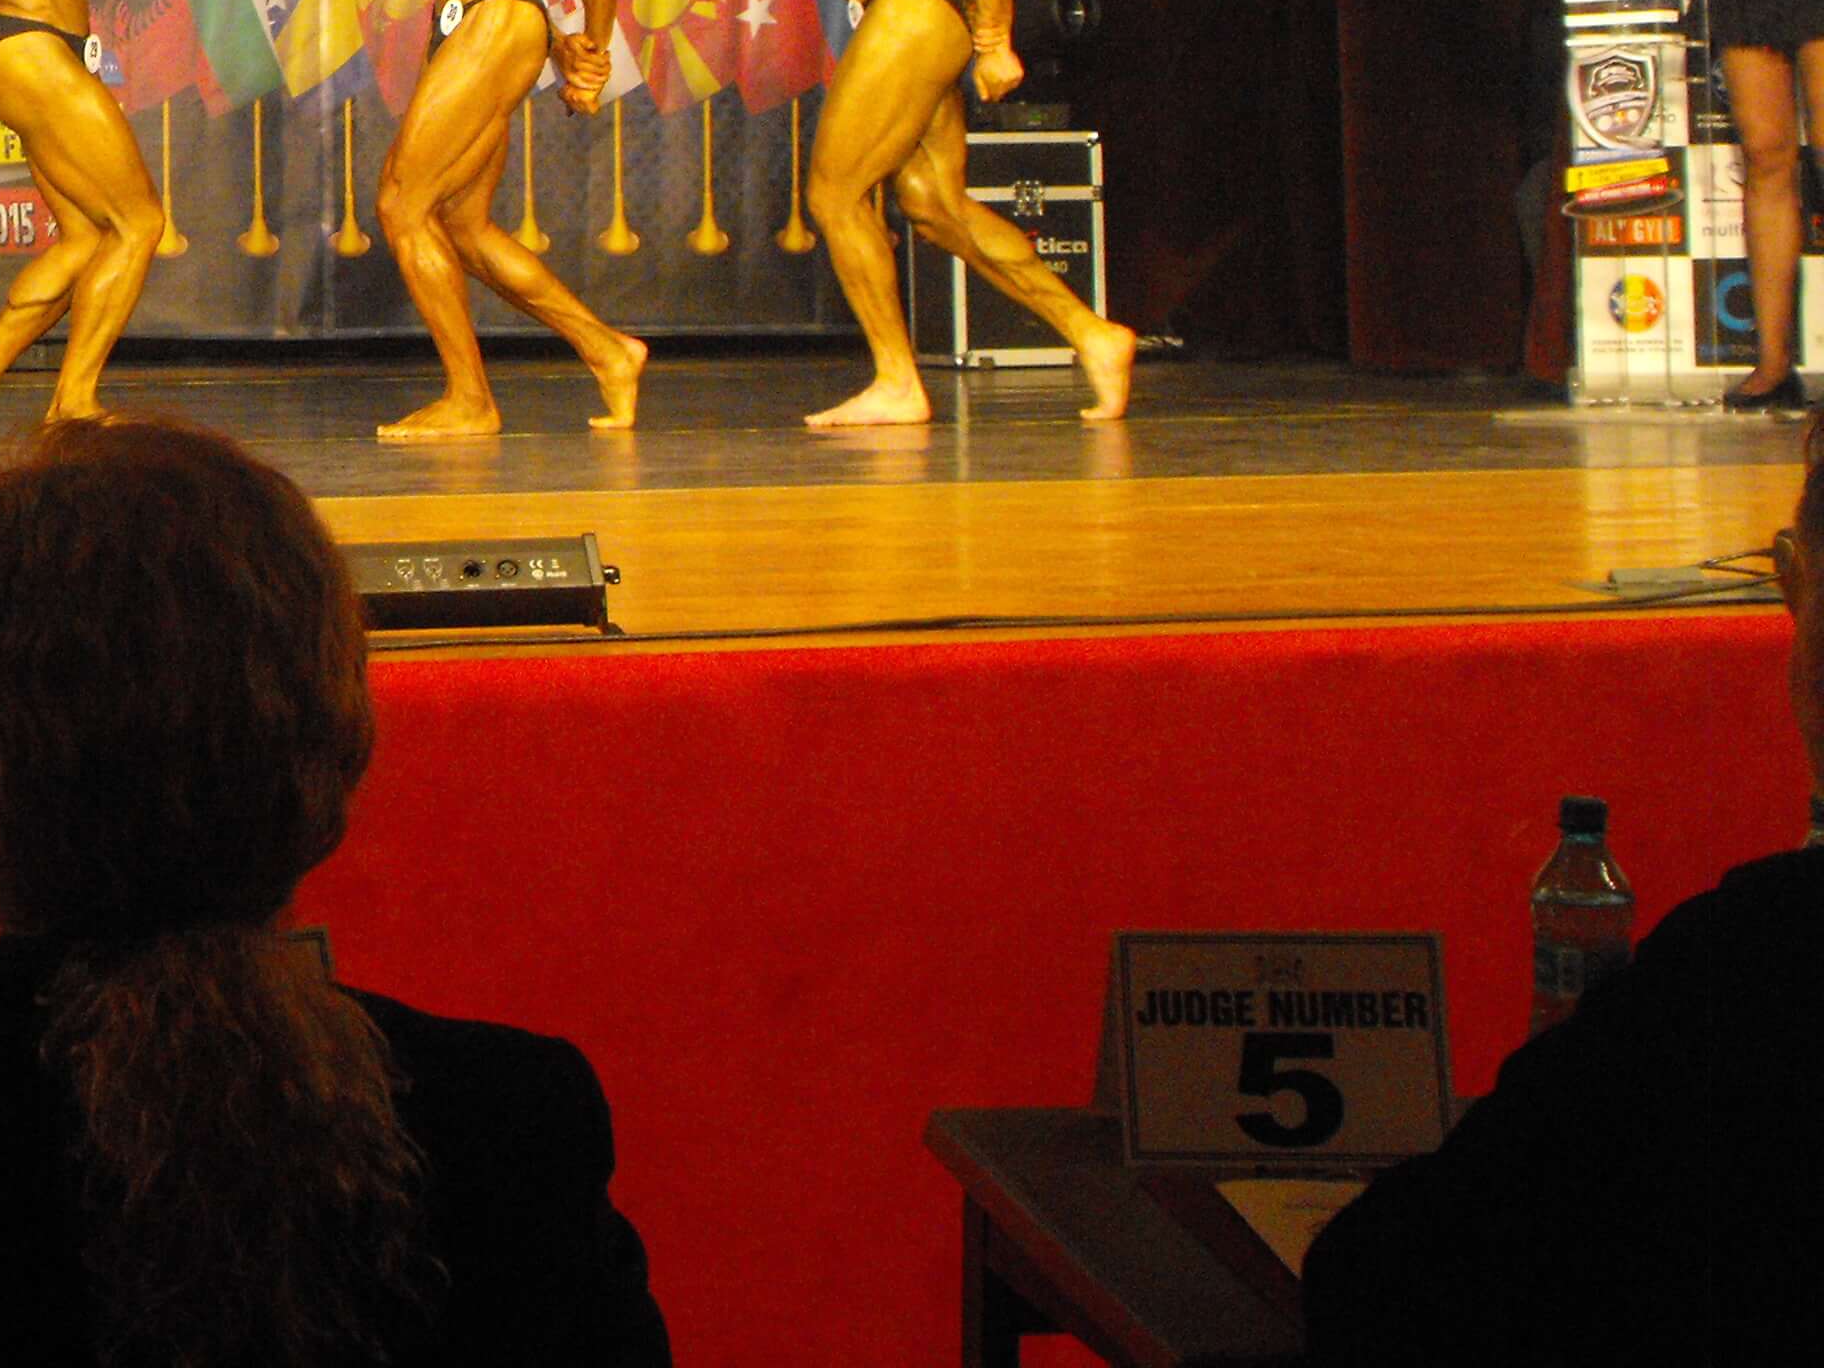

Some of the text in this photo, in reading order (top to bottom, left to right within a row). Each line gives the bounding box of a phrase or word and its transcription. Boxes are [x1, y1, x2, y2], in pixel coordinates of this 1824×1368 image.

[1137, 989, 1427, 1028] JUDGE NUMBER
[1235, 1032, 1344, 1148] 5
